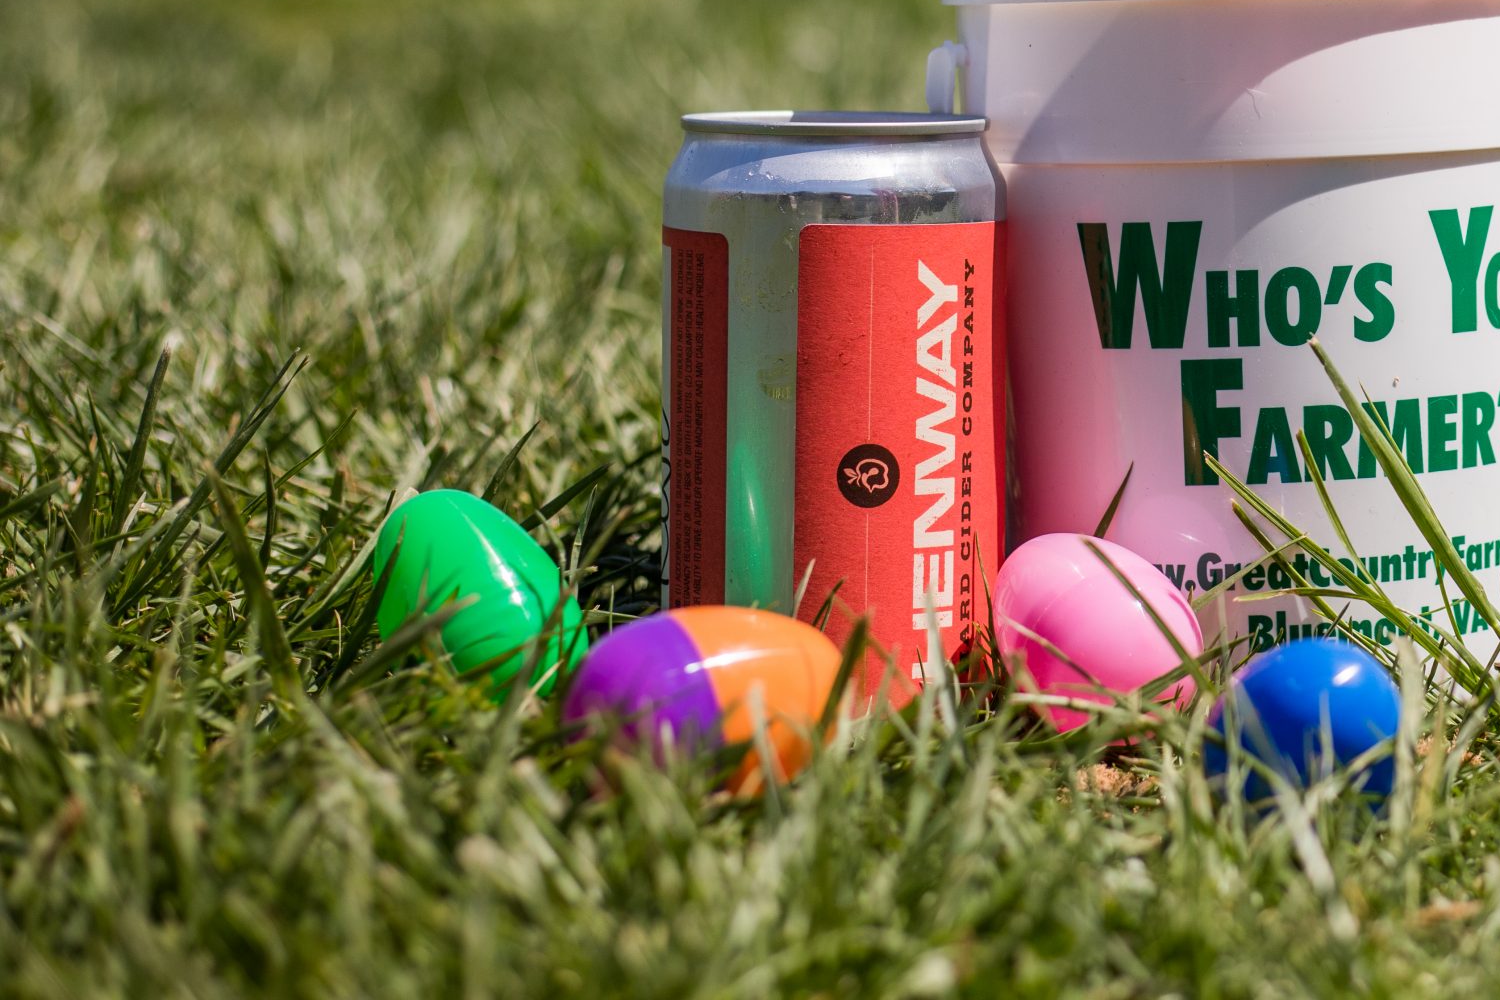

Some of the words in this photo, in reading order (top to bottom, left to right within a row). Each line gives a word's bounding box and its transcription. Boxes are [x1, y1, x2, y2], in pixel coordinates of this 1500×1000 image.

[1077, 220, 1395, 349] WHO'S
[962, 258, 975, 436] COMPANY
[911, 258, 958, 680] HENWAY
[960, 451, 972, 561] CIDER
[959, 573, 971, 661] ARD
[1452, 598, 1489, 636] VA
